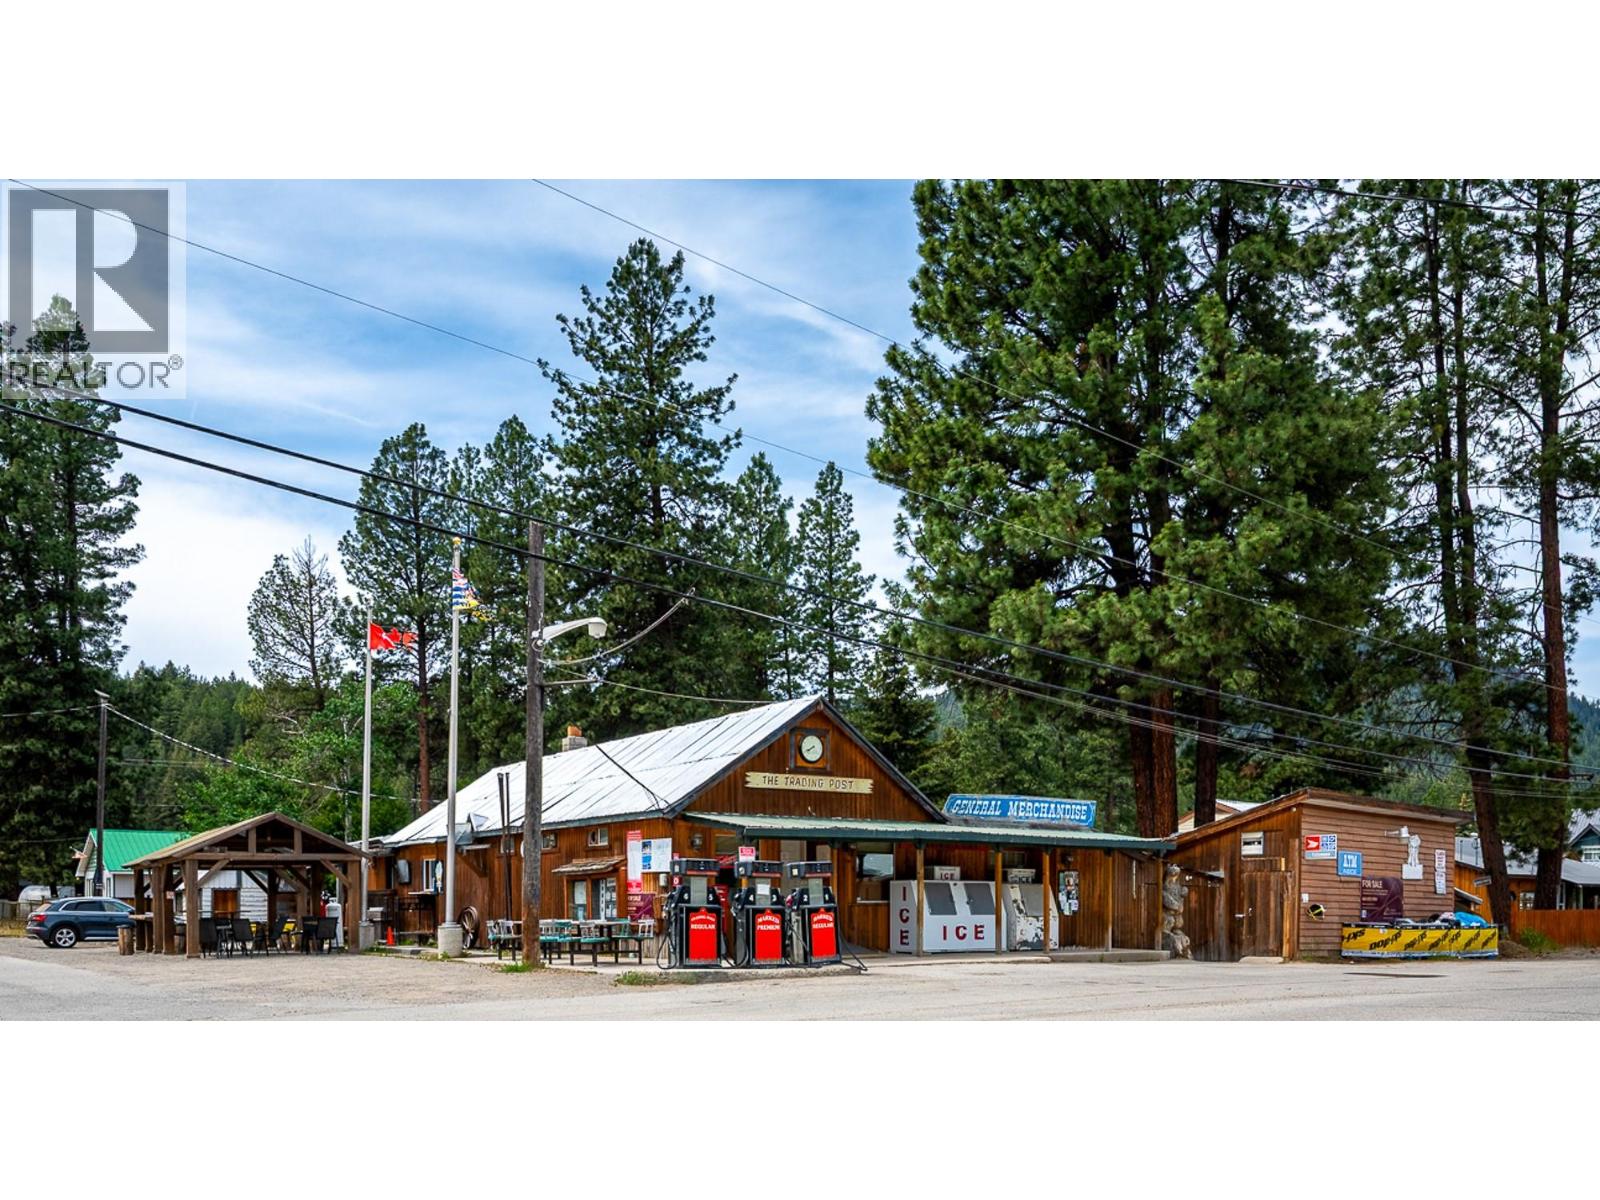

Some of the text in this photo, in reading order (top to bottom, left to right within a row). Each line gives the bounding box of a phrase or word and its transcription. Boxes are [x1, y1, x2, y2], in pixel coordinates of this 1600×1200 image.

[763, 775, 854, 790] THE TRADING POST
[952, 799, 1088, 820] GENERAL MERCHANDISE
[1343, 854, 1358, 868] ATM
[1362, 880, 1383, 889] FOR SALE
[942, 923, 985, 941] ICE
